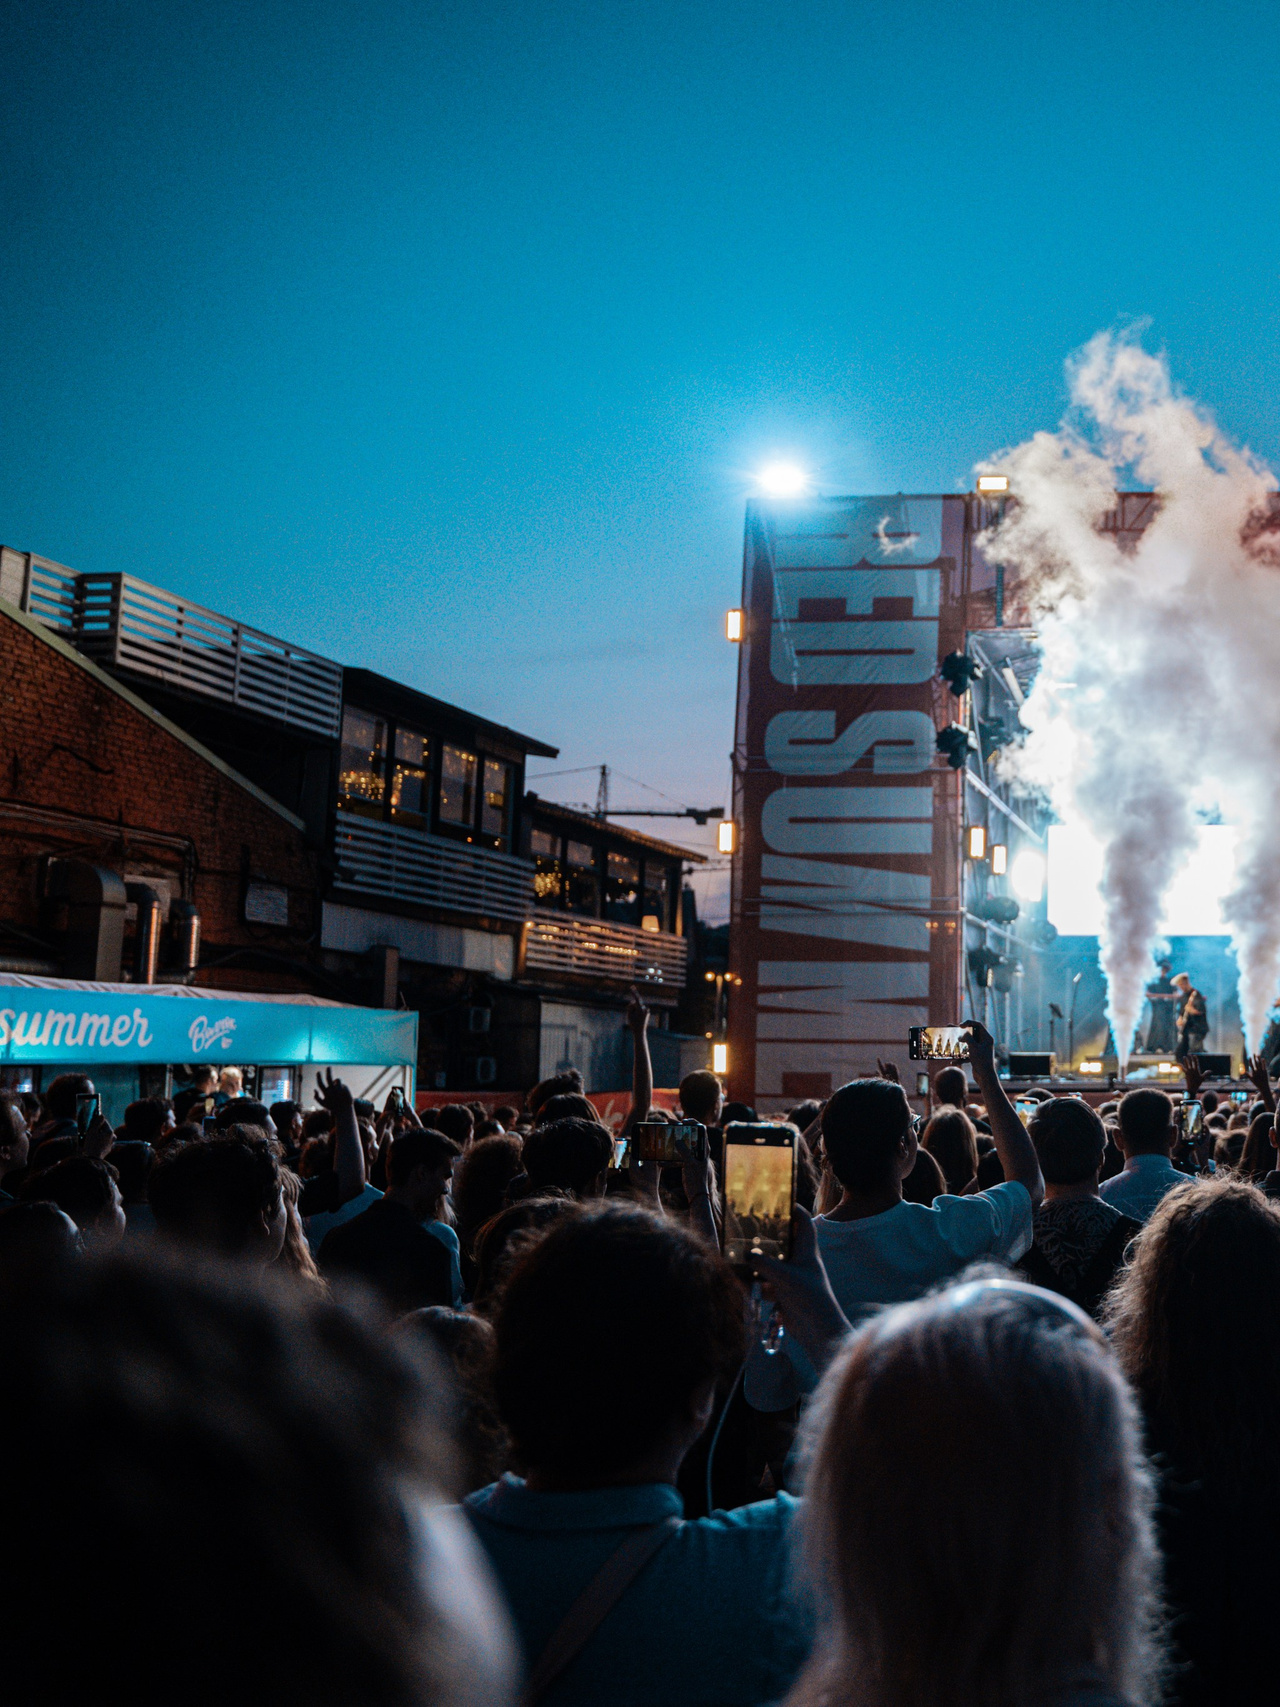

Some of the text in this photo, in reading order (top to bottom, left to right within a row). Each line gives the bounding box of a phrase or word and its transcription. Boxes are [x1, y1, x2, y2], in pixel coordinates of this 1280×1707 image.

[754, 496, 943, 1113] RED SUMME
[0, 1008, 153, 1048] summer
